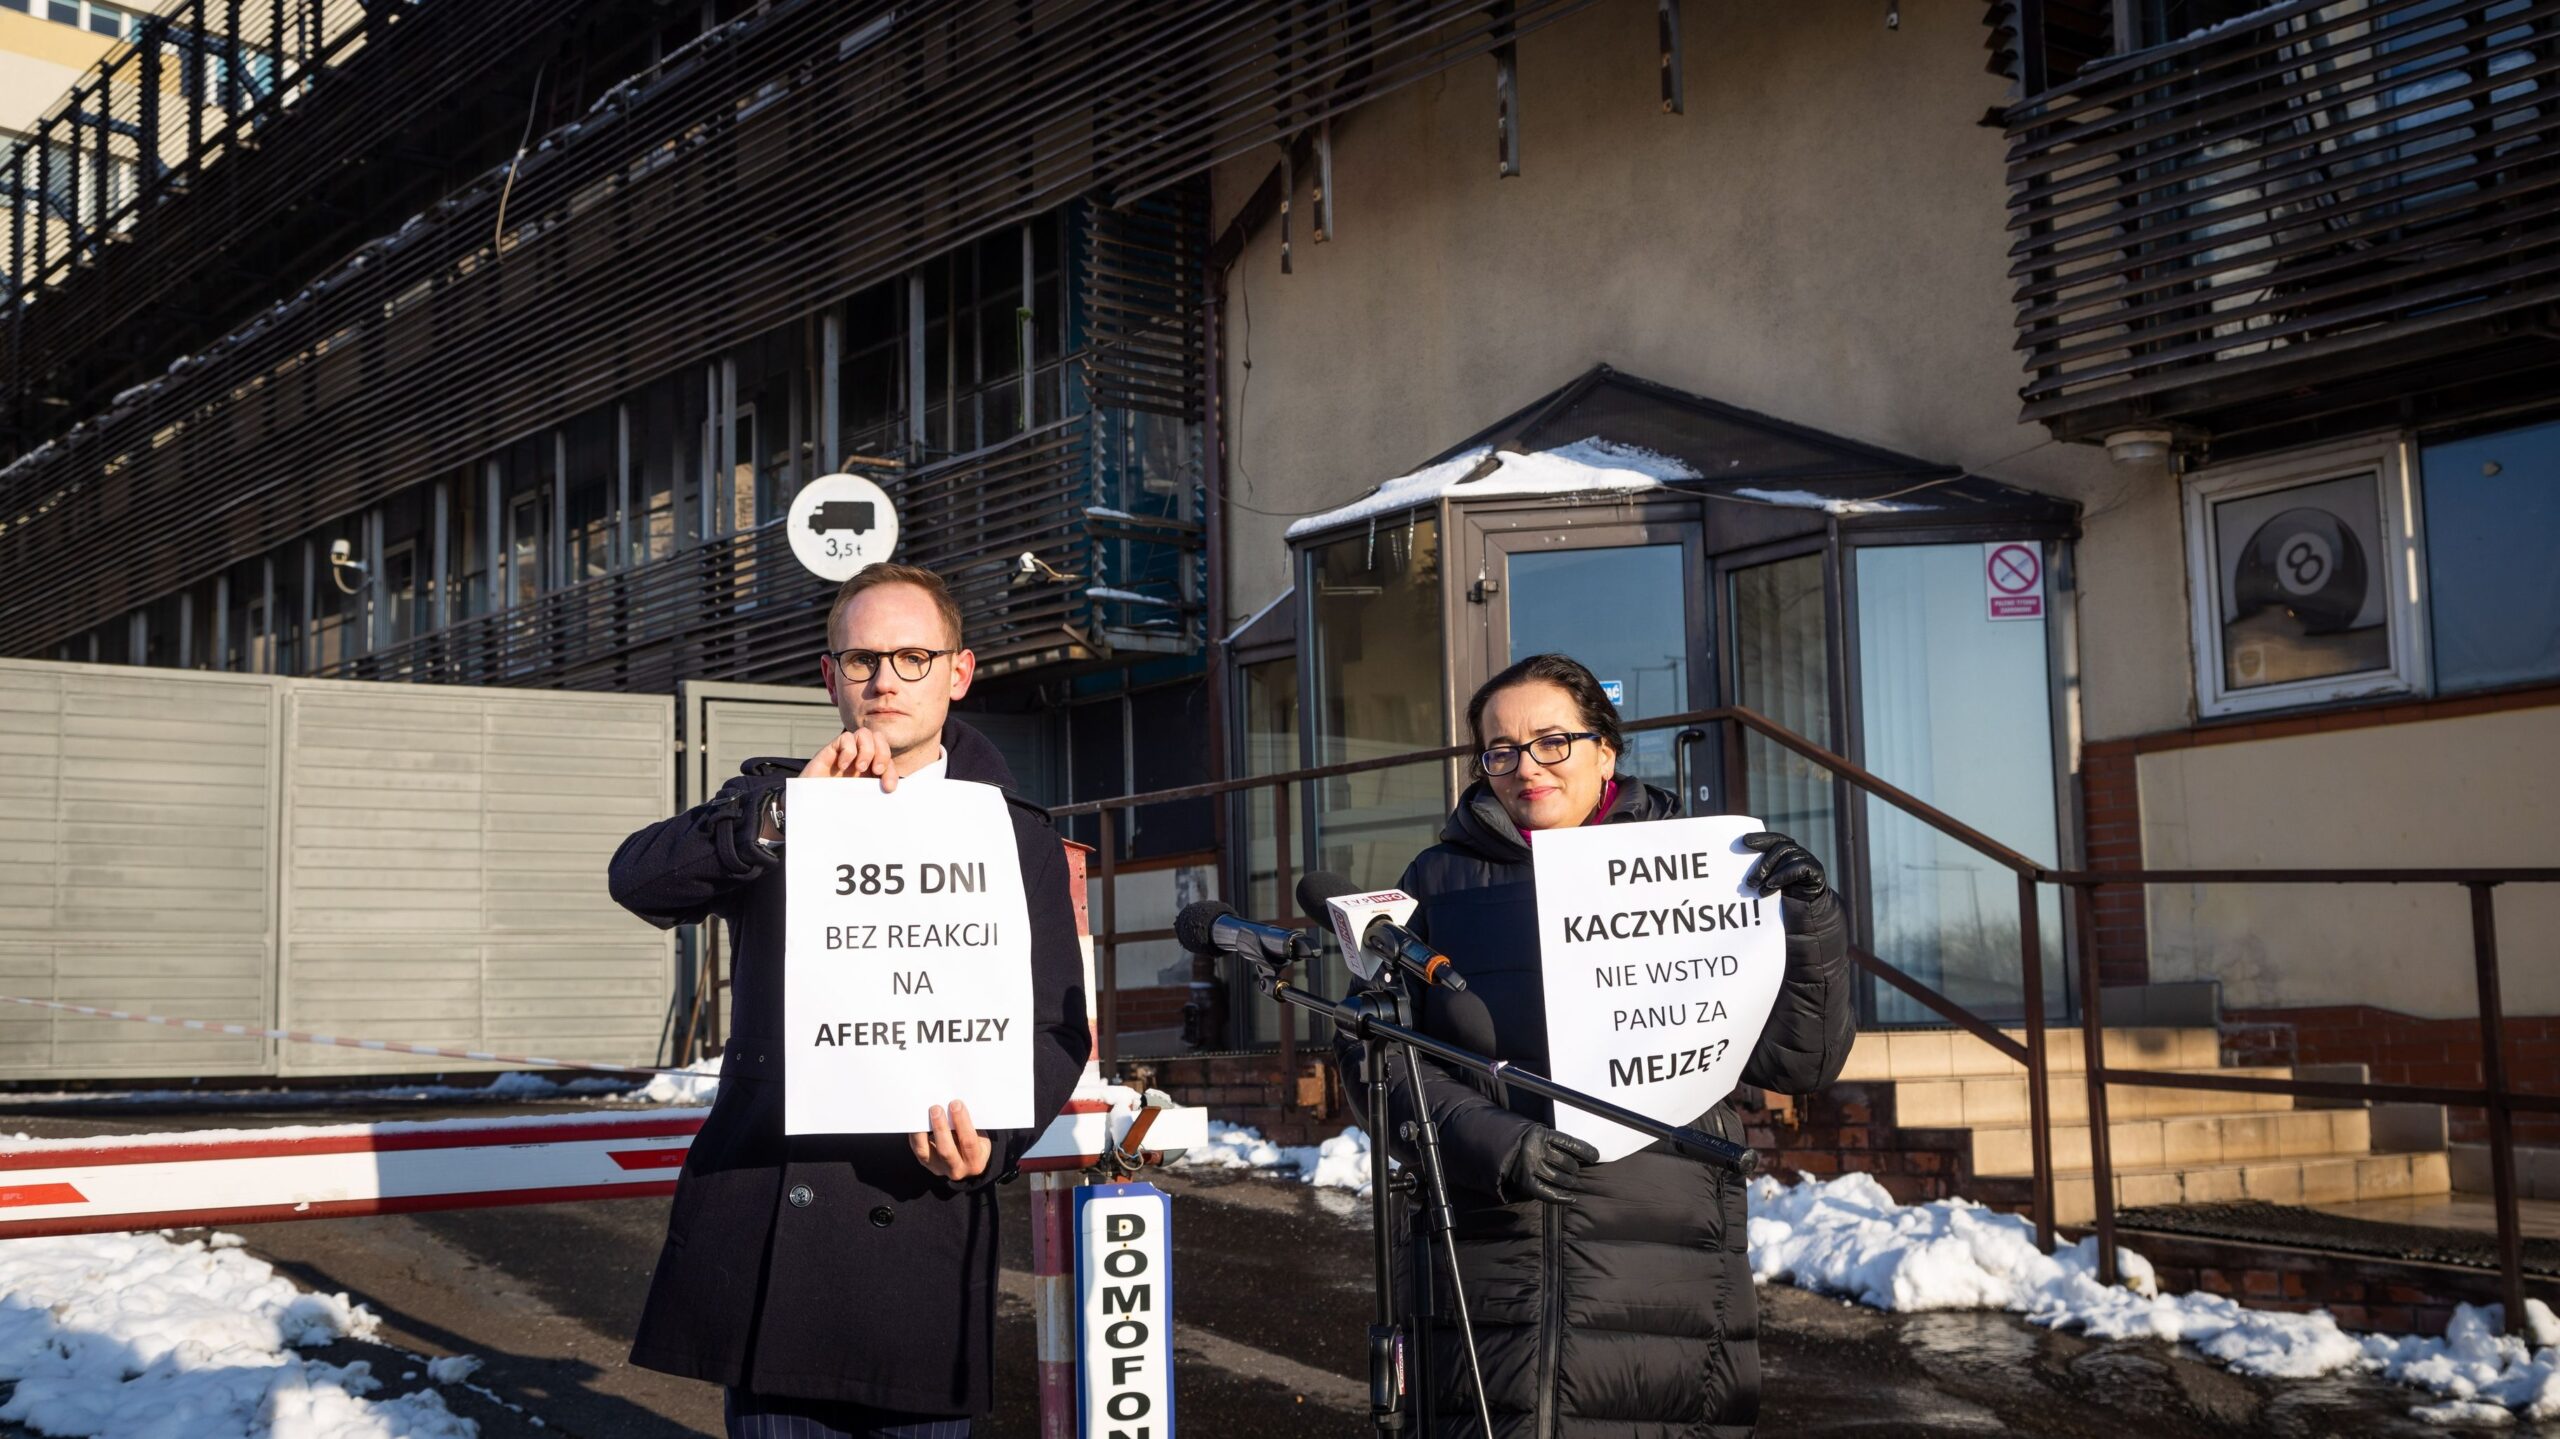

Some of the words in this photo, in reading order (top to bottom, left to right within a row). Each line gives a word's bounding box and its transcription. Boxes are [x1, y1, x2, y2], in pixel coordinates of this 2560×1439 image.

[826, 538, 852, 559] 3,5
[2286, 541, 2324, 585] 8
[836, 864, 904, 895] 385
[921, 863, 985, 893] DNI
[1608, 852, 1709, 886] PANIE
[1371, 893, 1403, 904] INFO
[827, 926, 877, 949] BEZ
[889, 923, 997, 948] REAKCJI
[1563, 899, 1762, 943] KACZYŃSKI!
[894, 971, 933, 995] NA
[1596, 964, 1638, 988] NIE
[1646, 955, 1738, 983] WSTYD
[1614, 1003, 1687, 1031] PANU
[1695, 1000, 1728, 1023] ZA
[815, 1022, 906, 1050] AFERĘ
[917, 1018, 1009, 1043] MEJZY
[1608, 1038, 1730, 1087] MEJZĘ?
